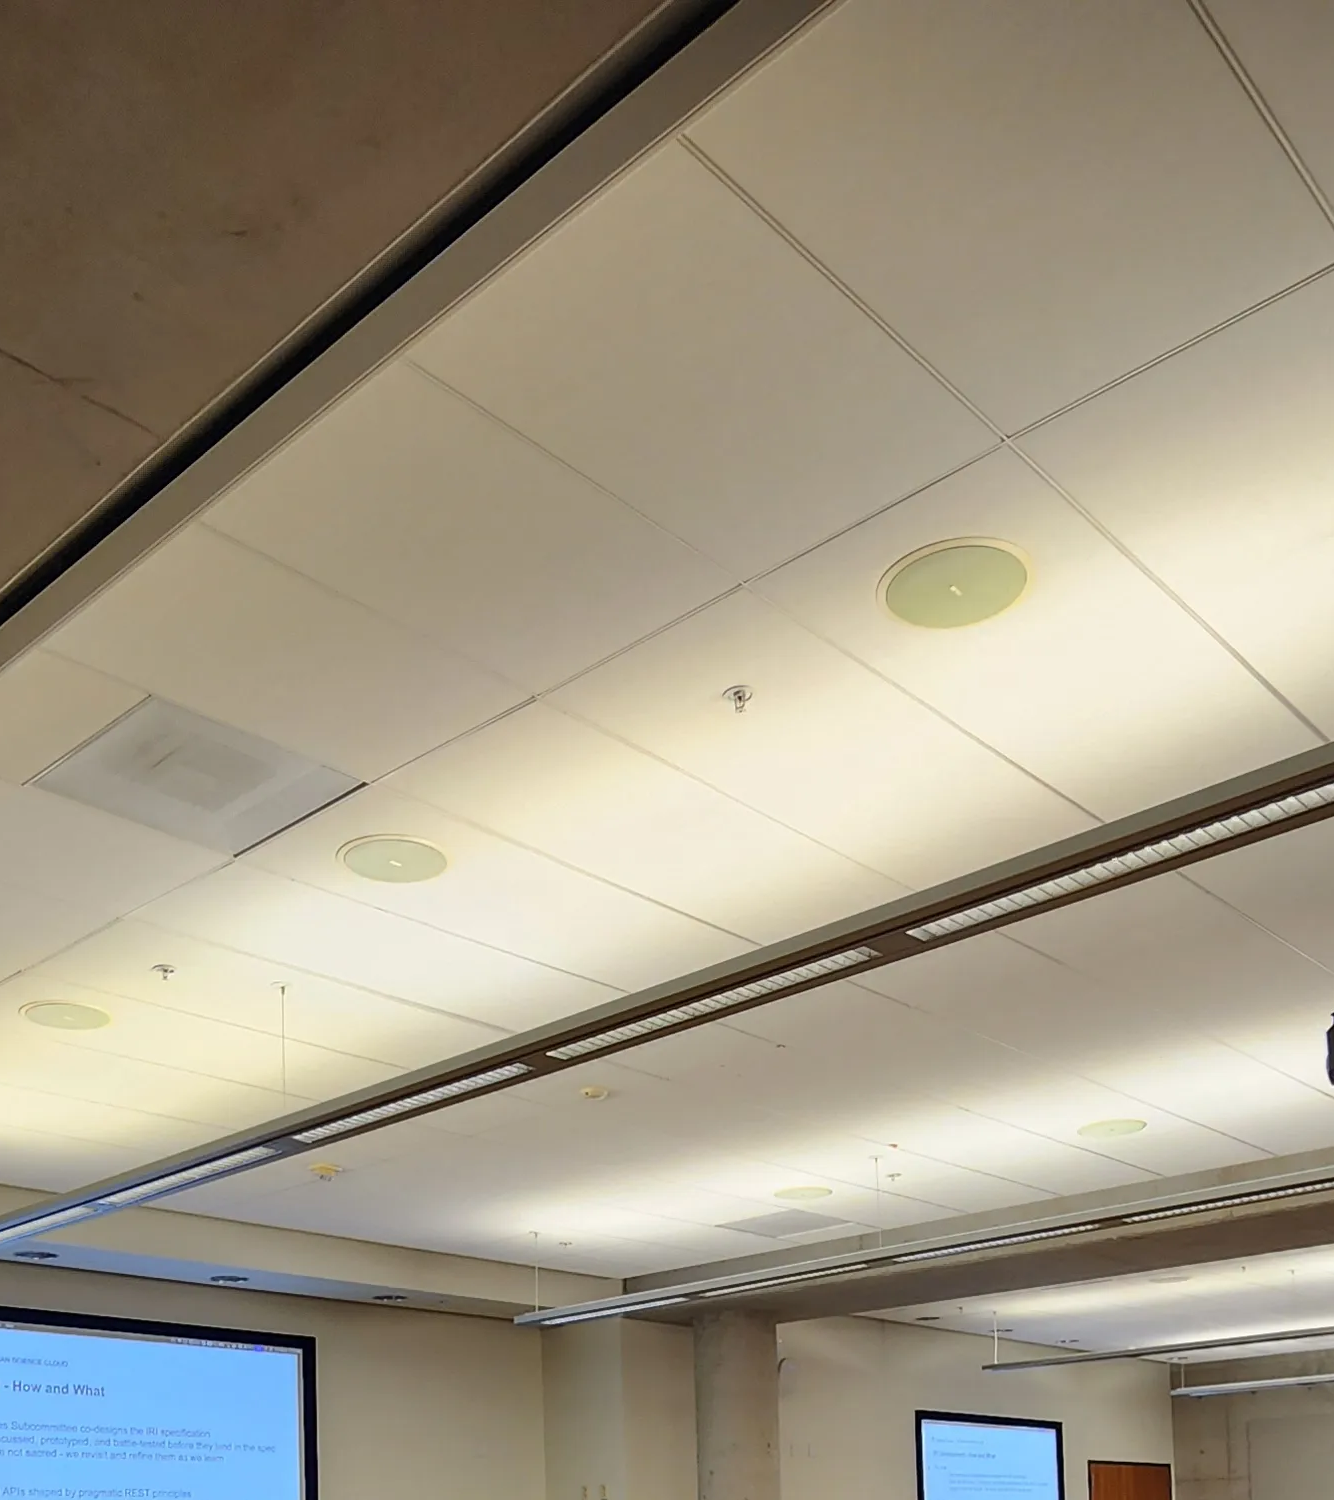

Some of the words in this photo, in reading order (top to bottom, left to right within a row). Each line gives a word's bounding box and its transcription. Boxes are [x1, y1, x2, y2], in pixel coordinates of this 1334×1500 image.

[13, 1380, 42, 1393] How
[45, 1383, 69, 1394] and
[72, 1384, 105, 1397] What
[11, 1421, 78, 1432] Subcommittee
[80, 1425, 128, 1436] co-designs
[130, 1427, 144, 1435] the
[146, 1428, 158, 1436] IRI
[161, 1429, 211, 1438] specification
[95, 1438, 110, 1447] and
[113, 1438, 165, 1448] battle-tested
[168, 1441, 194, 1449] before
[197, 1442, 213, 1452] they
[8, 1448, 23, 1457] not
[26, 1449, 56, 1458] sacred
[110, 1452, 126, 1460] and
[129, 1452, 153, 1460] refine
[155, 1453, 175, 1461] them
[3, 1487, 25, 1497] APIs
[29, 1488, 63, 1498] shaped
[65, 1488, 76, 1499] by
[79, 1489, 122, 1499] pragmatic
[125, 1489, 149, 1497] REST
